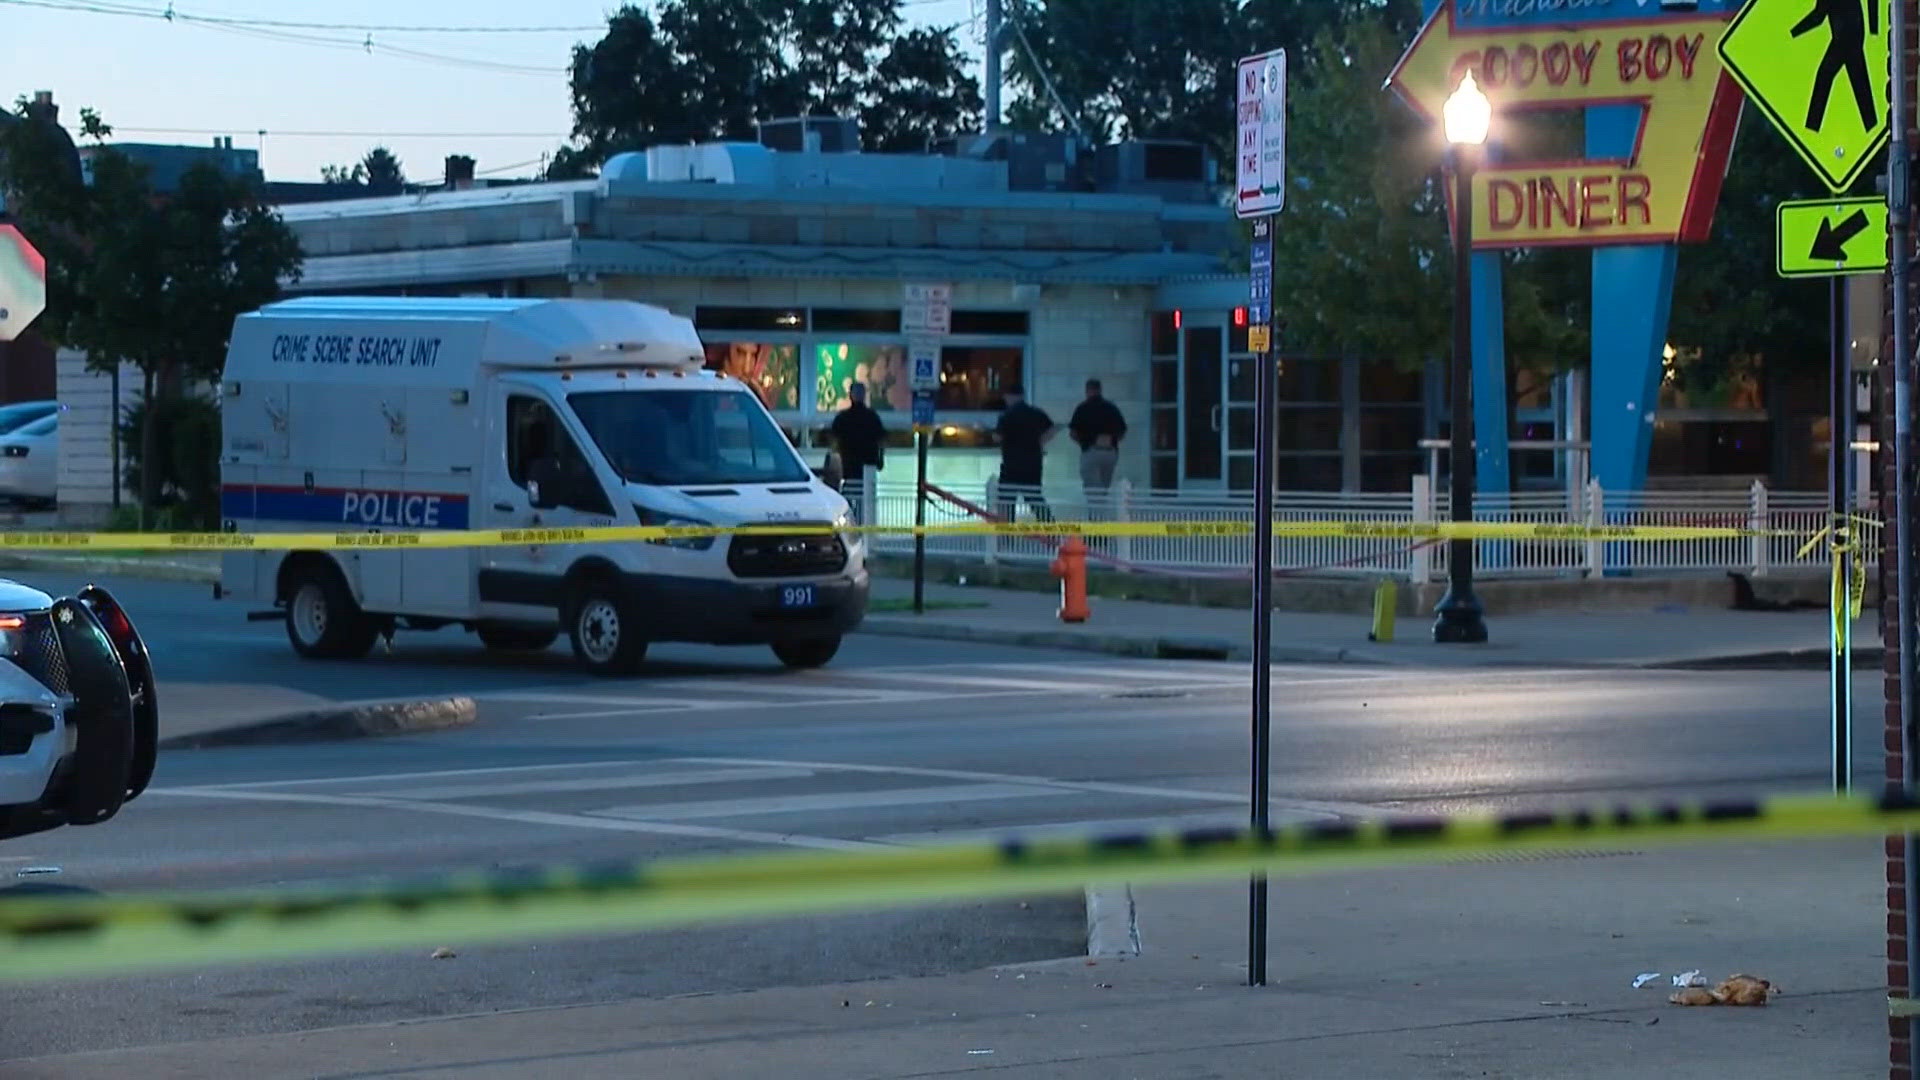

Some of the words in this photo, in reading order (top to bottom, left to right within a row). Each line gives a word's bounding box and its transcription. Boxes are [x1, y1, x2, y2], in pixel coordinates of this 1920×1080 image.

[1617, 33, 1704, 84] BOY
[1245, 70, 1256, 96] NO
[1243, 128, 1257, 150] ANY
[1243, 153, 1257, 175] TIME
[1487, 174, 1652, 232] DINER
[272, 334, 310, 363] CRIME
[312, 335, 353, 364] SCENE
[356, 336, 407, 366] SEARCH
[410, 337, 441, 368] UNIT
[343, 491, 441, 527] POLICE
[784, 587, 812, 605] 991
